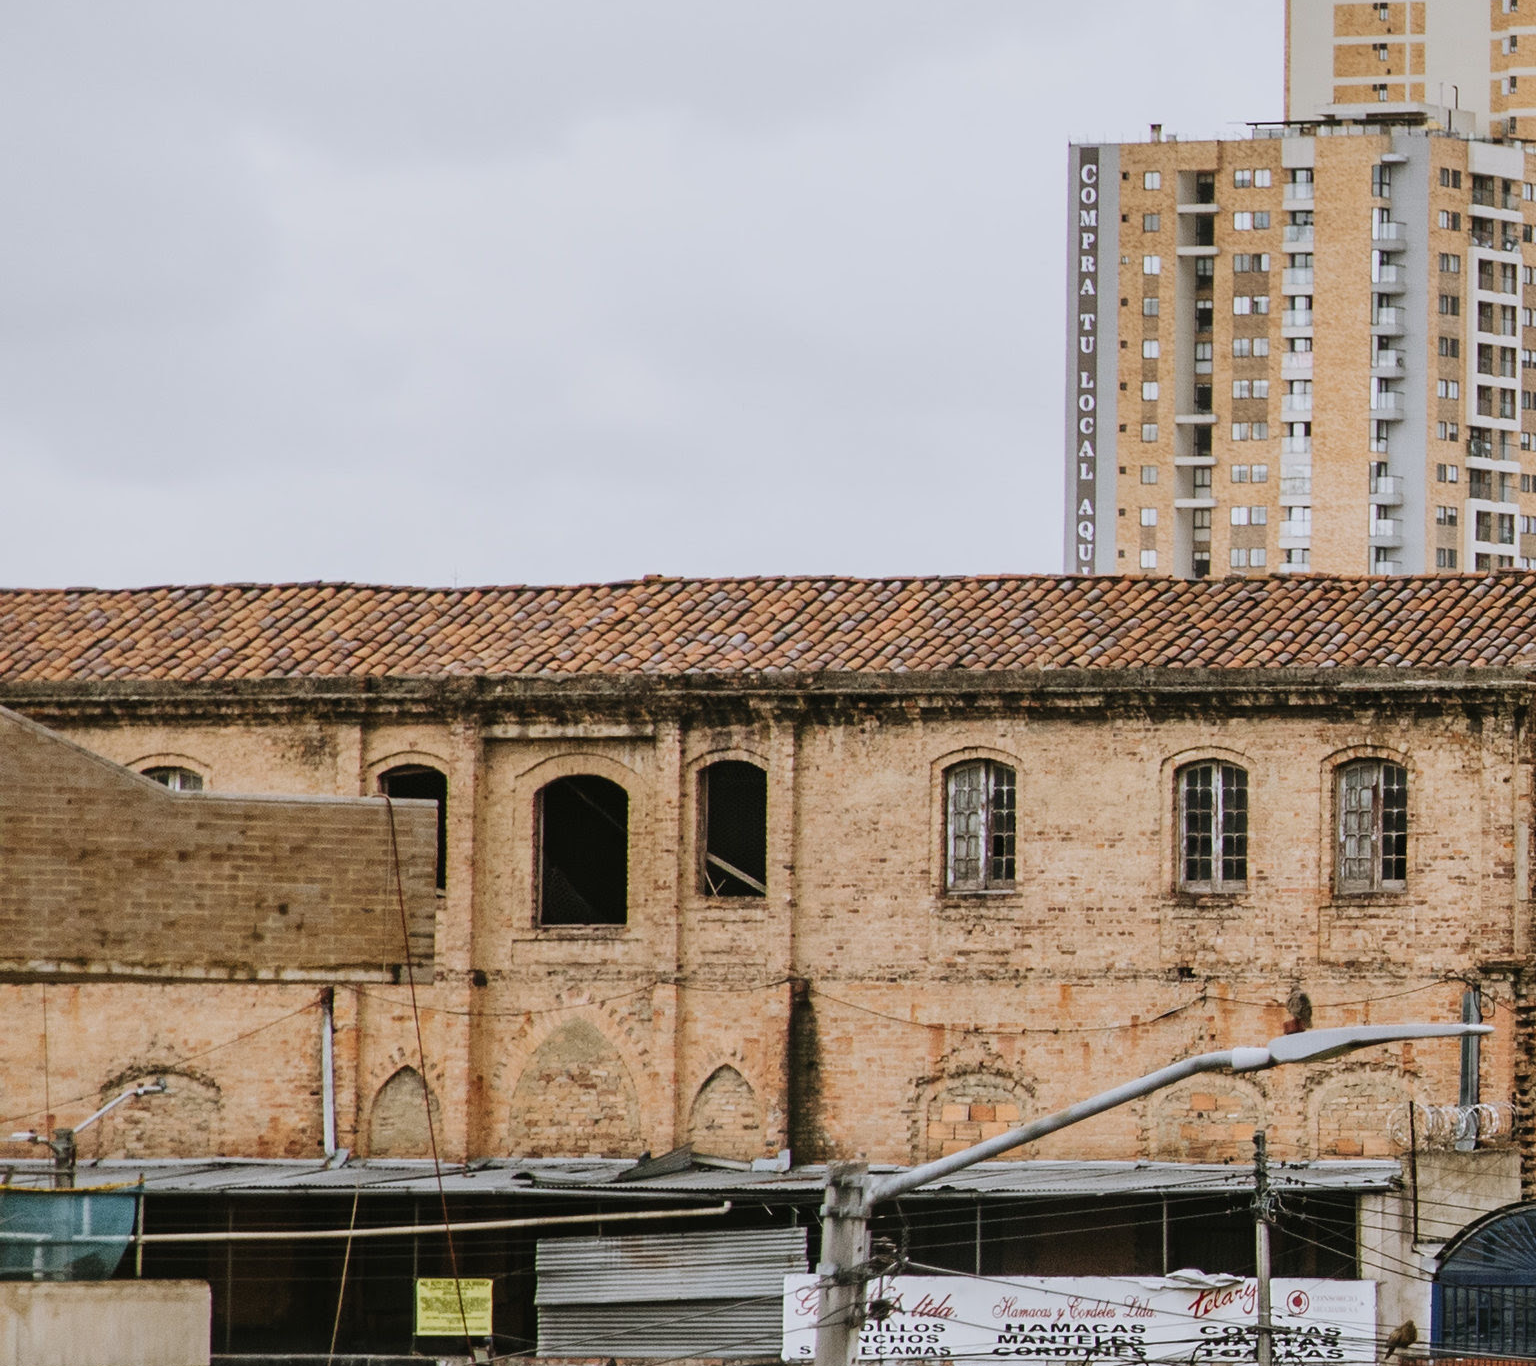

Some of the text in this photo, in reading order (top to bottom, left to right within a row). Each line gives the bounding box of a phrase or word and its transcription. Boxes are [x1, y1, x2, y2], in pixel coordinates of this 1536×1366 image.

[1080, 163, 1098, 296] COMPRA
[1079, 313, 1096, 355] TU
[1078, 371, 1095, 481] LOCAL
[992, 1296, 1052, 1319] Hamacas
[1054, 1307, 1066, 1323] y
[1067, 1295, 1117, 1319] Cordeles
[997, 1334, 1145, 1345] MANTELES
[1005, 1323, 1147, 1334] HAMACAS
[992, 1346, 1147, 1357] CORDONES
